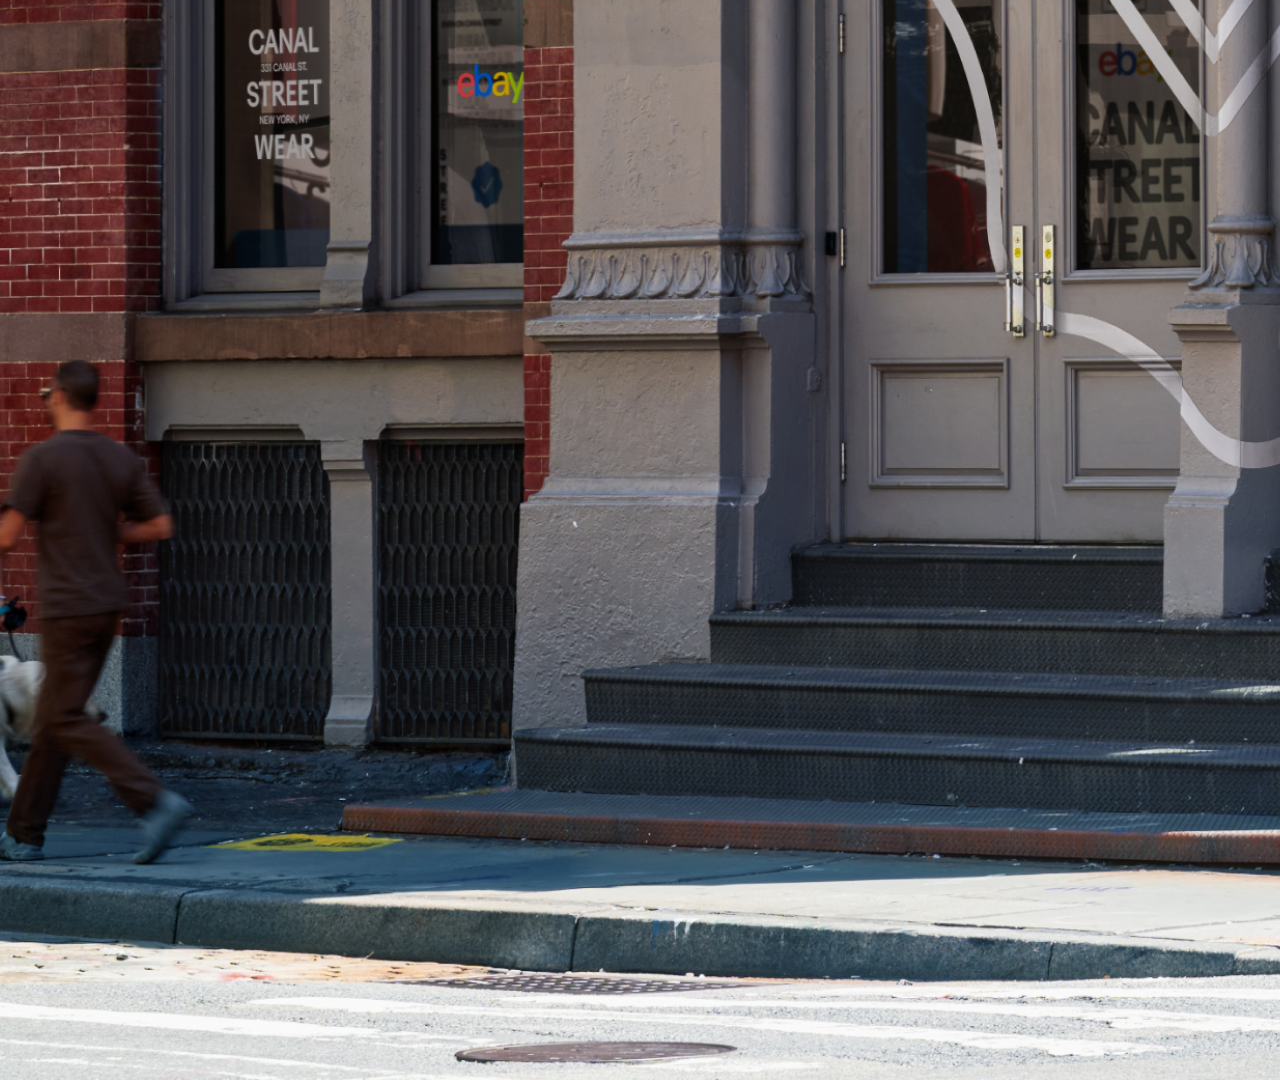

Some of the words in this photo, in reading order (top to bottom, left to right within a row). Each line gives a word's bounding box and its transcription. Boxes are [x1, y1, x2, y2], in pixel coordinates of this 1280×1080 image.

[248, 26, 319, 55] CANAL
[260, 63, 272, 73] 331
[273, 62, 297, 72] CANAL
[246, 79, 322, 108] STREET
[457, 64, 524, 103] ebay
[259, 115, 275, 125] NEW
[276, 114, 298, 126] YORK,
[299, 114, 310, 124] NY
[254, 133, 316, 160] WEAR
